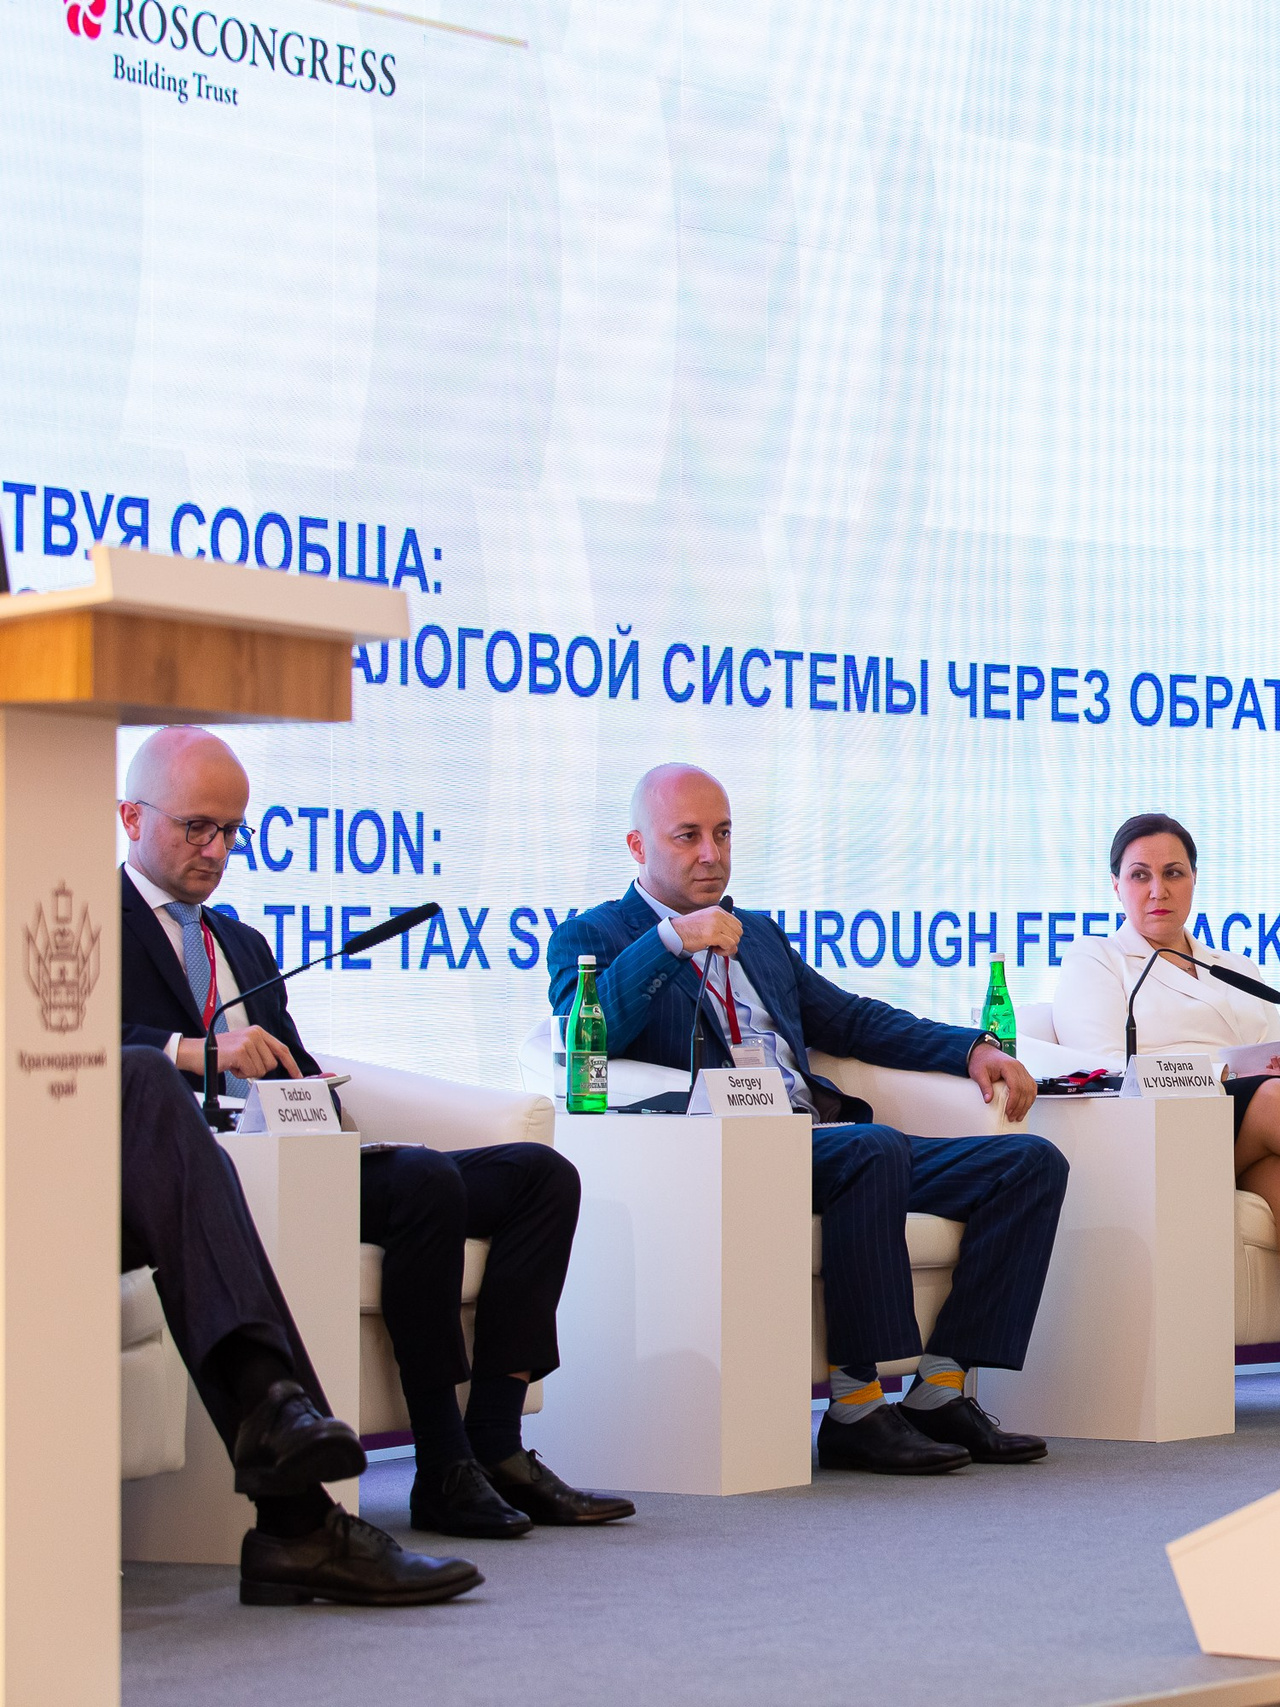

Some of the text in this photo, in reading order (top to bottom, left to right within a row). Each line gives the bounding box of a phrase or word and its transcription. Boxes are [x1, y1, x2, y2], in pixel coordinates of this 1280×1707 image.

[113, 0, 397, 97] ROSCONGRESS
[113, 53, 239, 106] Building Trust
[663, 641, 929, 717] СИСТЕМЫ
[947, 660, 1111, 725] ЧЕРЕЗ
[263, 904, 373, 970] THE
[389, 906, 491, 970] TAX
[745, 909, 998, 968] HROUGH
[1156, 1060, 1194, 1074] Tatyana
[728, 1075, 762, 1091] Sergey
[1143, 1075, 1215, 1089] ILYUSHNIKOVA
[281, 1087, 311, 1101] Tadzio
[727, 1093, 774, 1107] MIRONOV
[278, 1107, 327, 1122] SCHILLING
